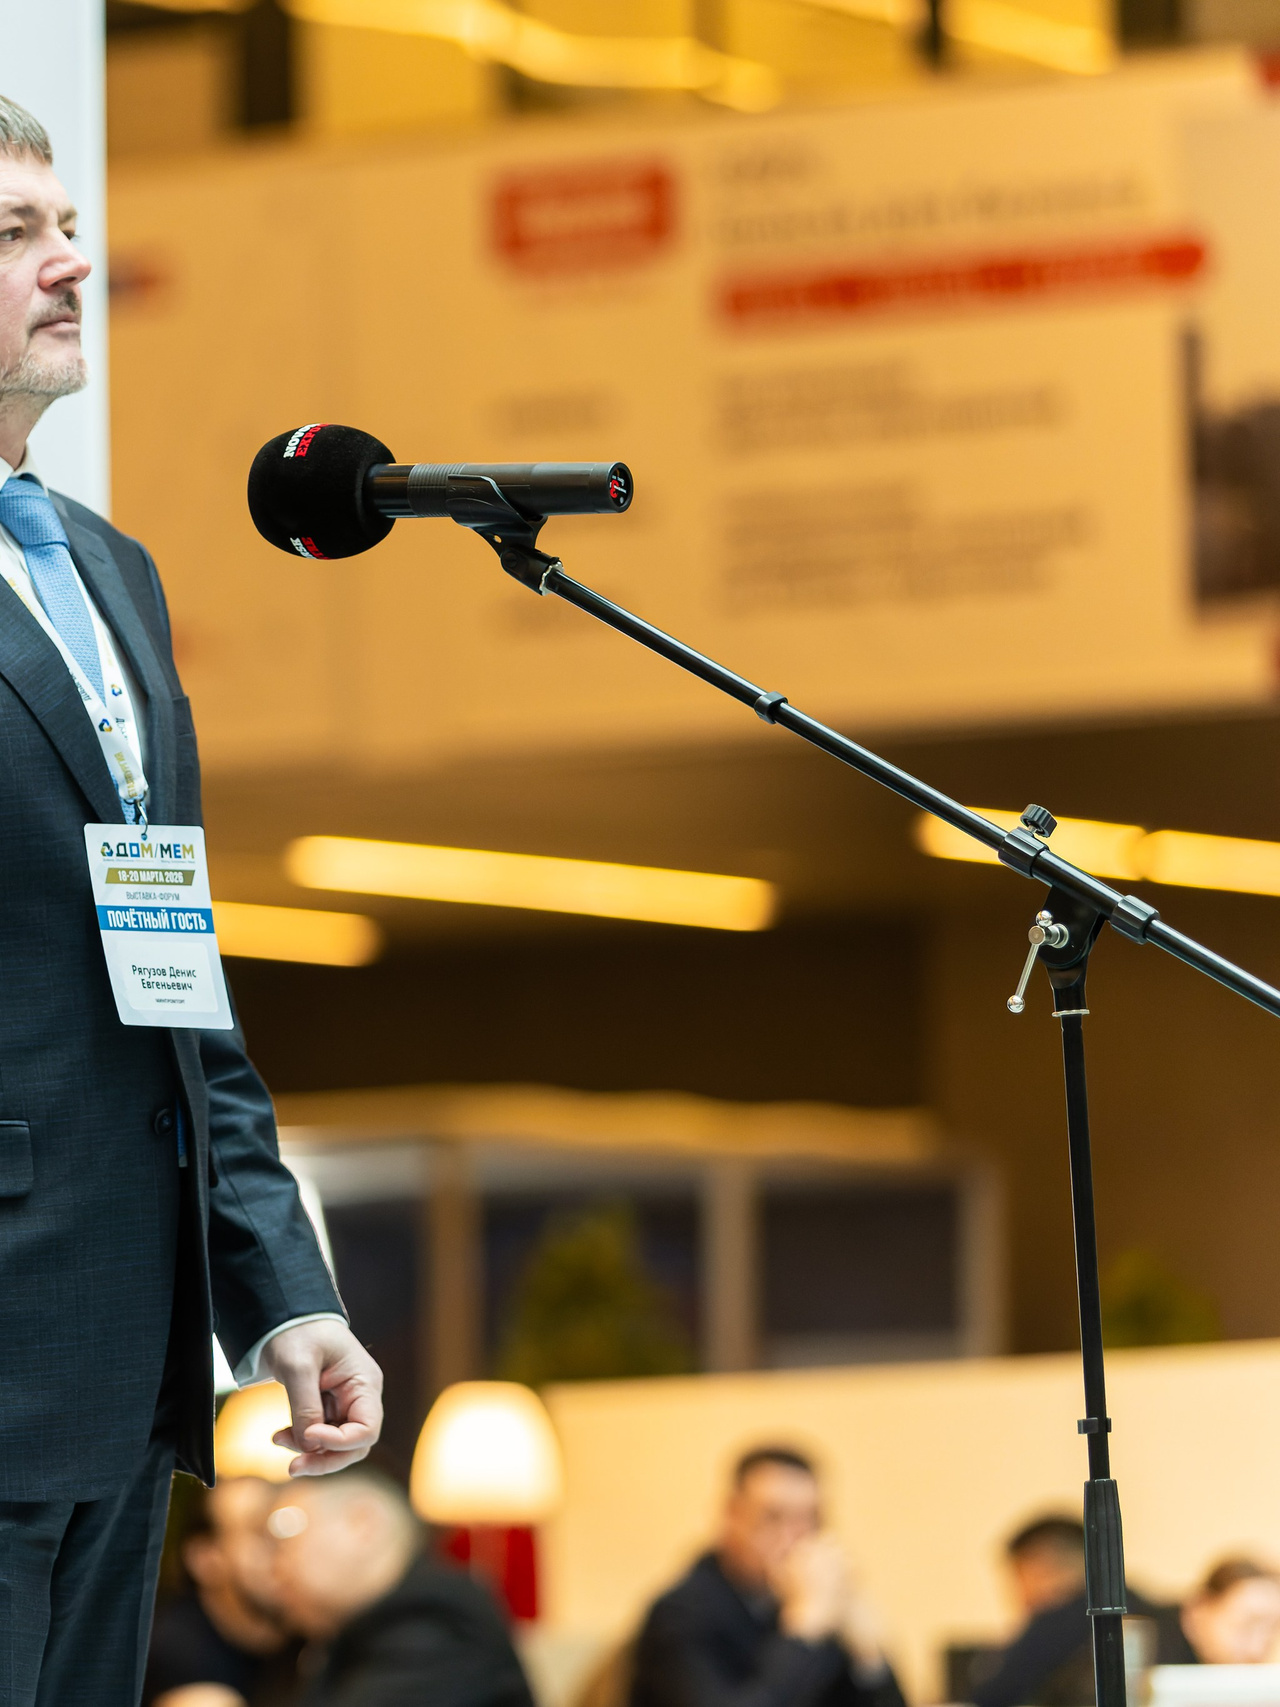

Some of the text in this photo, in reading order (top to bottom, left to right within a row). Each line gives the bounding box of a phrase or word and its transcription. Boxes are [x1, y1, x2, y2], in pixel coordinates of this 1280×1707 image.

[118, 870, 184, 883] 18-20 МАРТА 2026
[107, 908, 207, 930] ПОЧЁТНЫЙ ГОСТЬ
[131, 964, 197, 979] Рягузов Денис
[141, 978, 193, 991] Евгеньевич
